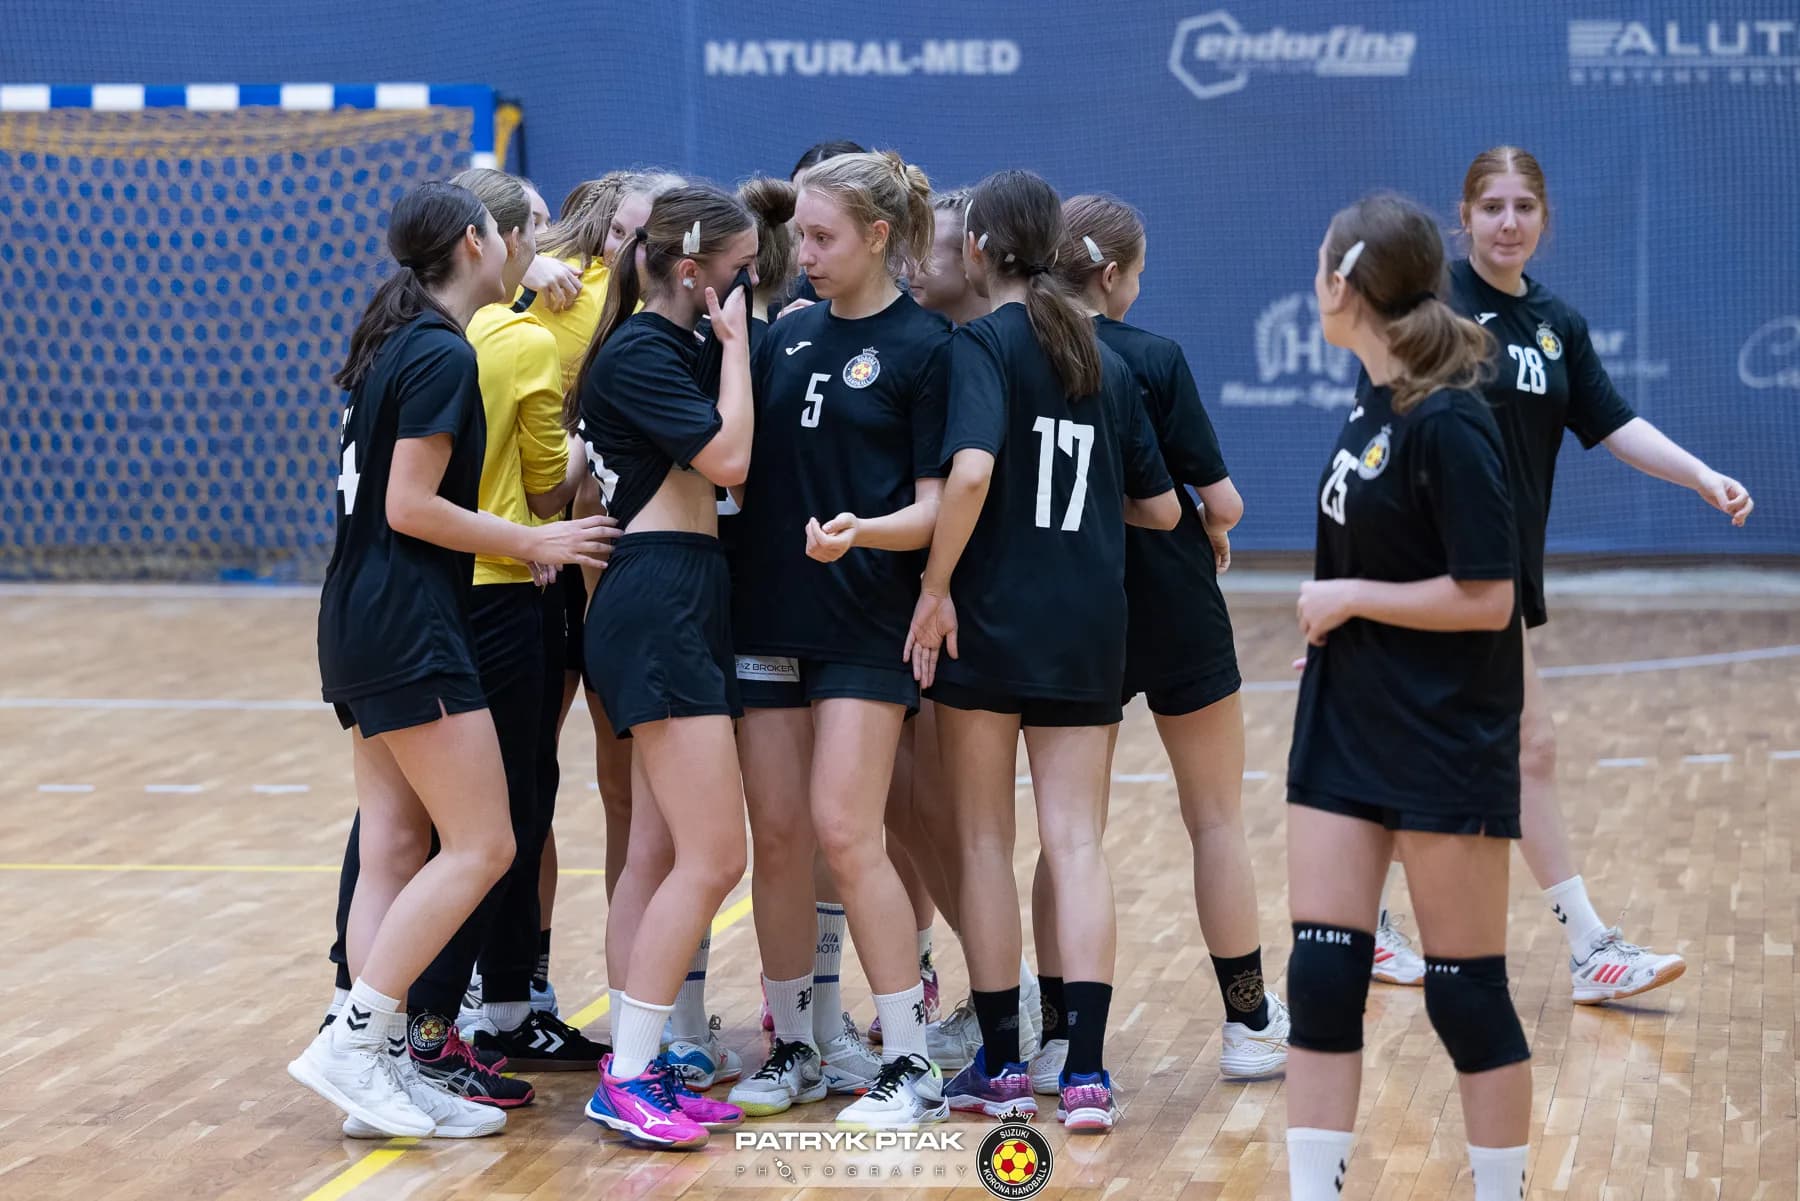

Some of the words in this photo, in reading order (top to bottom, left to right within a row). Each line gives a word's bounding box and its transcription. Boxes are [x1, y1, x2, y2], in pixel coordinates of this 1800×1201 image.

[705, 40, 1020, 75] NATURAL-MED
[1507, 344, 1546, 394] 28
[801, 372, 832, 428] 5
[1032, 416, 1094, 531] 17
[1321, 448, 1359, 525] 25
[752, 663, 794, 673] BROKER
